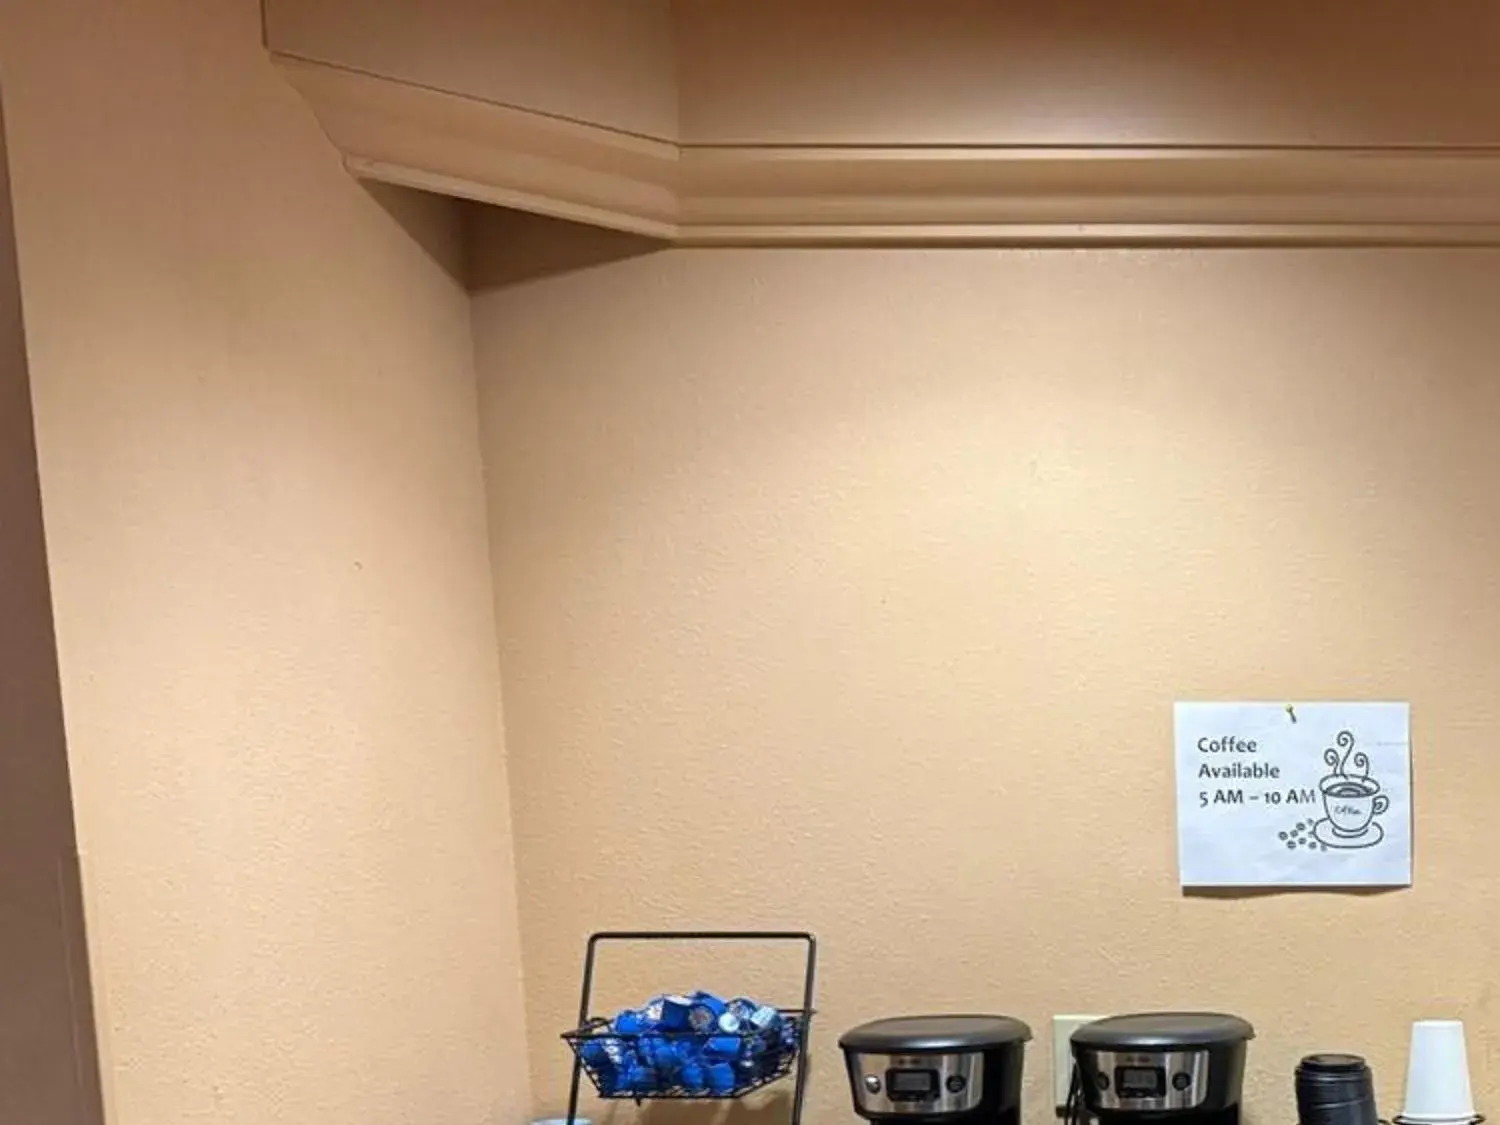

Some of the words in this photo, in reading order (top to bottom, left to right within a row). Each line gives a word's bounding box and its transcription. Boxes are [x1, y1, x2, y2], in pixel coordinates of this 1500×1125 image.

[1197, 735, 1258, 753] Coffee
[1198, 762, 1281, 779] Available
[1199, 791, 1209, 808] 5
[1213, 789, 1243, 805] AM
[1264, 790, 1282, 805] 10
[1285, 789, 1317, 805] AM
